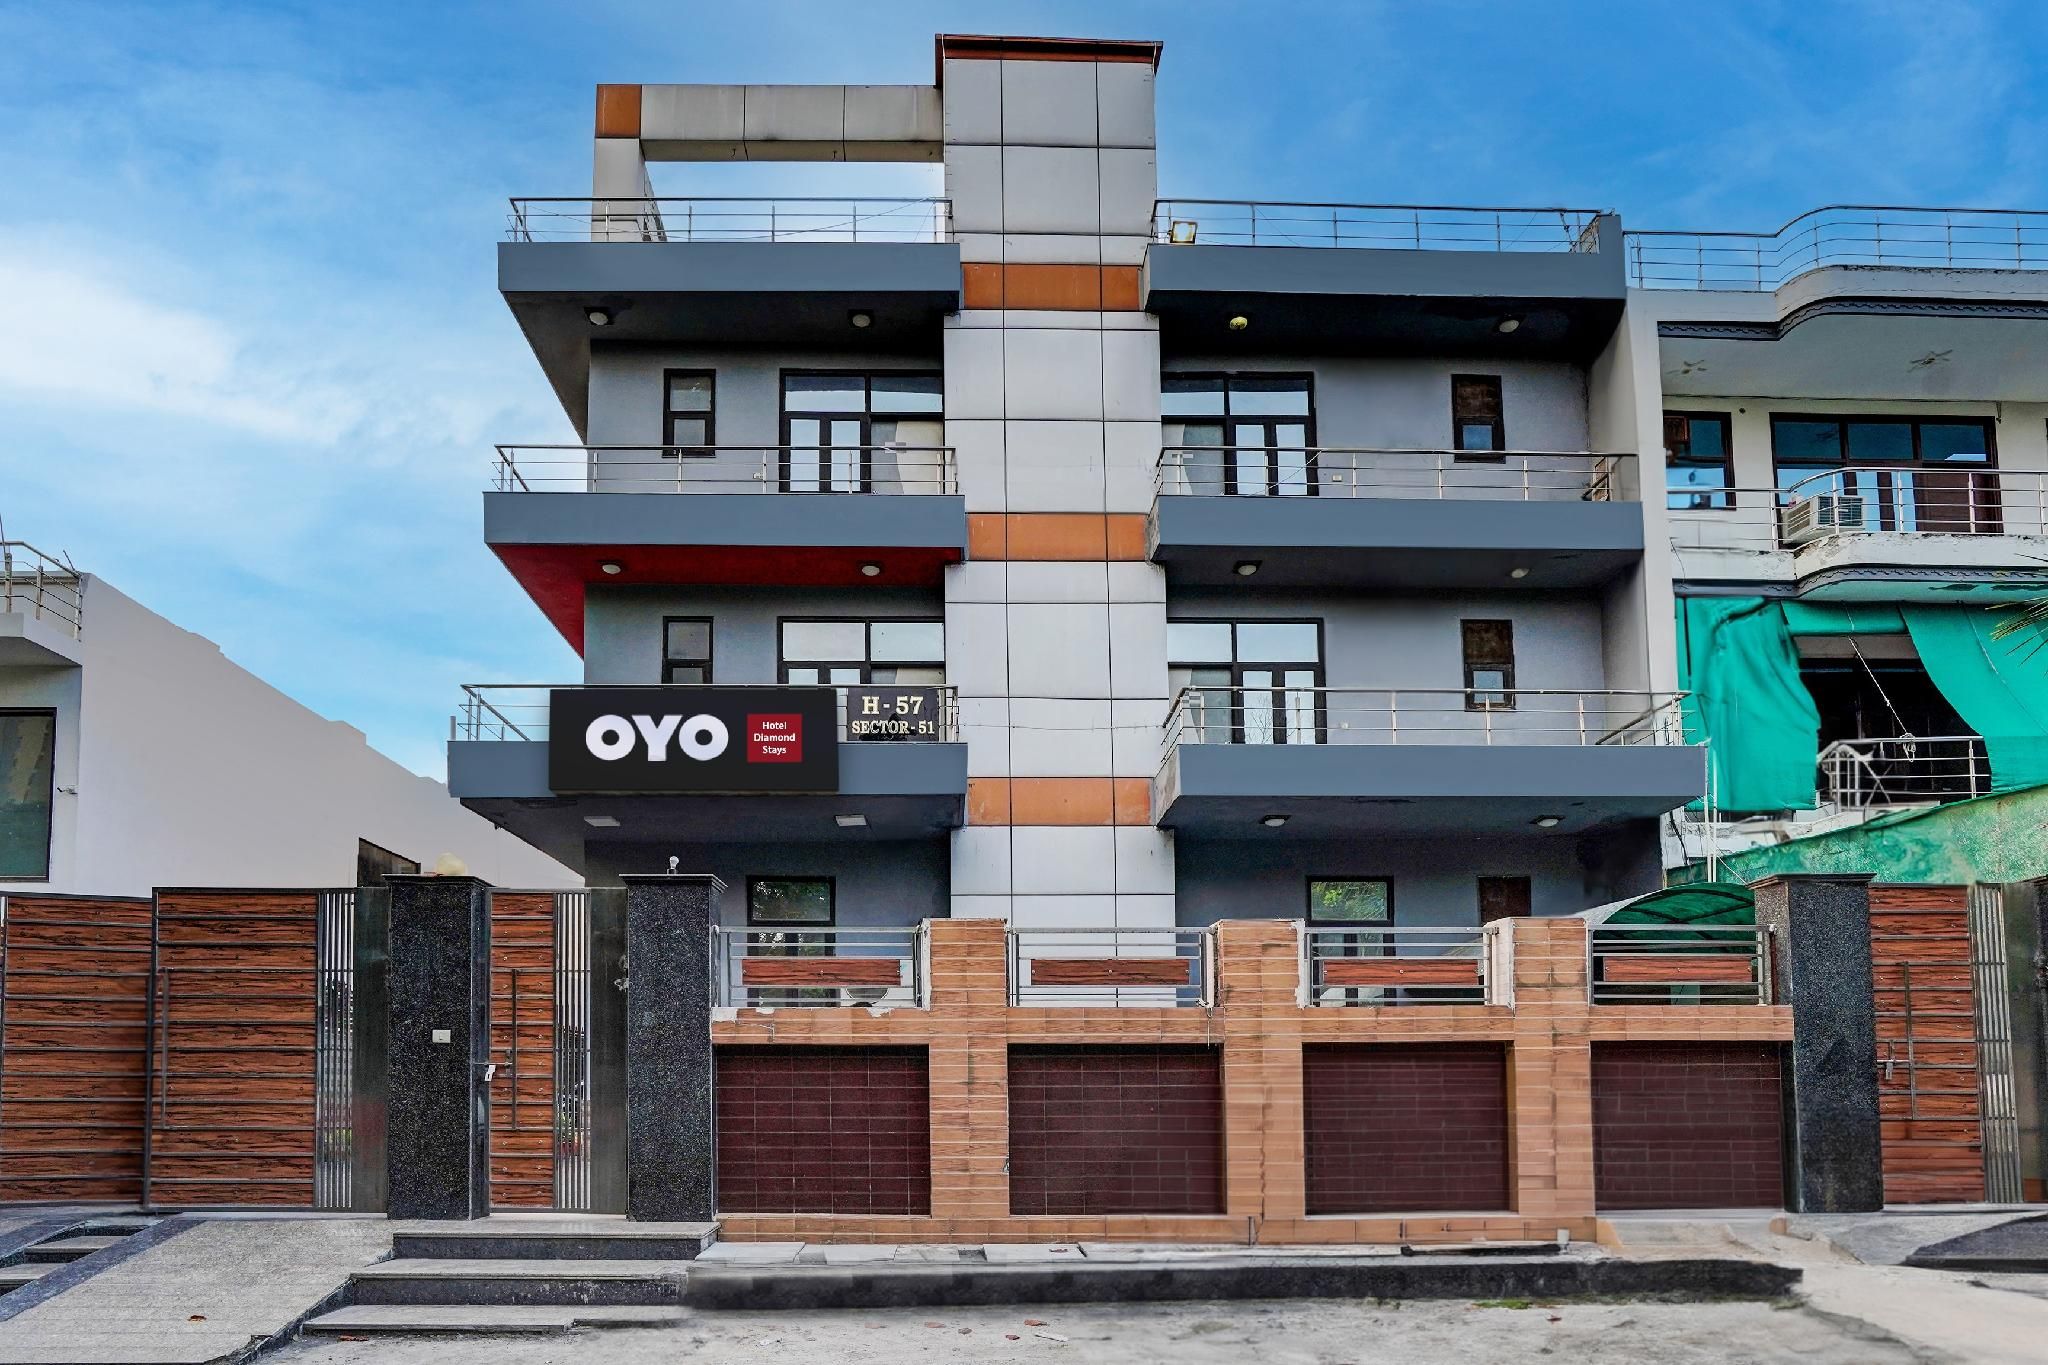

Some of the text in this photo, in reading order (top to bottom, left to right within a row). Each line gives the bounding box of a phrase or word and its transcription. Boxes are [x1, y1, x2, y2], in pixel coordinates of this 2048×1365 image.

[762, 721, 787, 730] Hotel
[585, 714, 729, 762] OYO
[753, 732, 796, 742] Diamond
[762, 745, 787, 756] Stays
